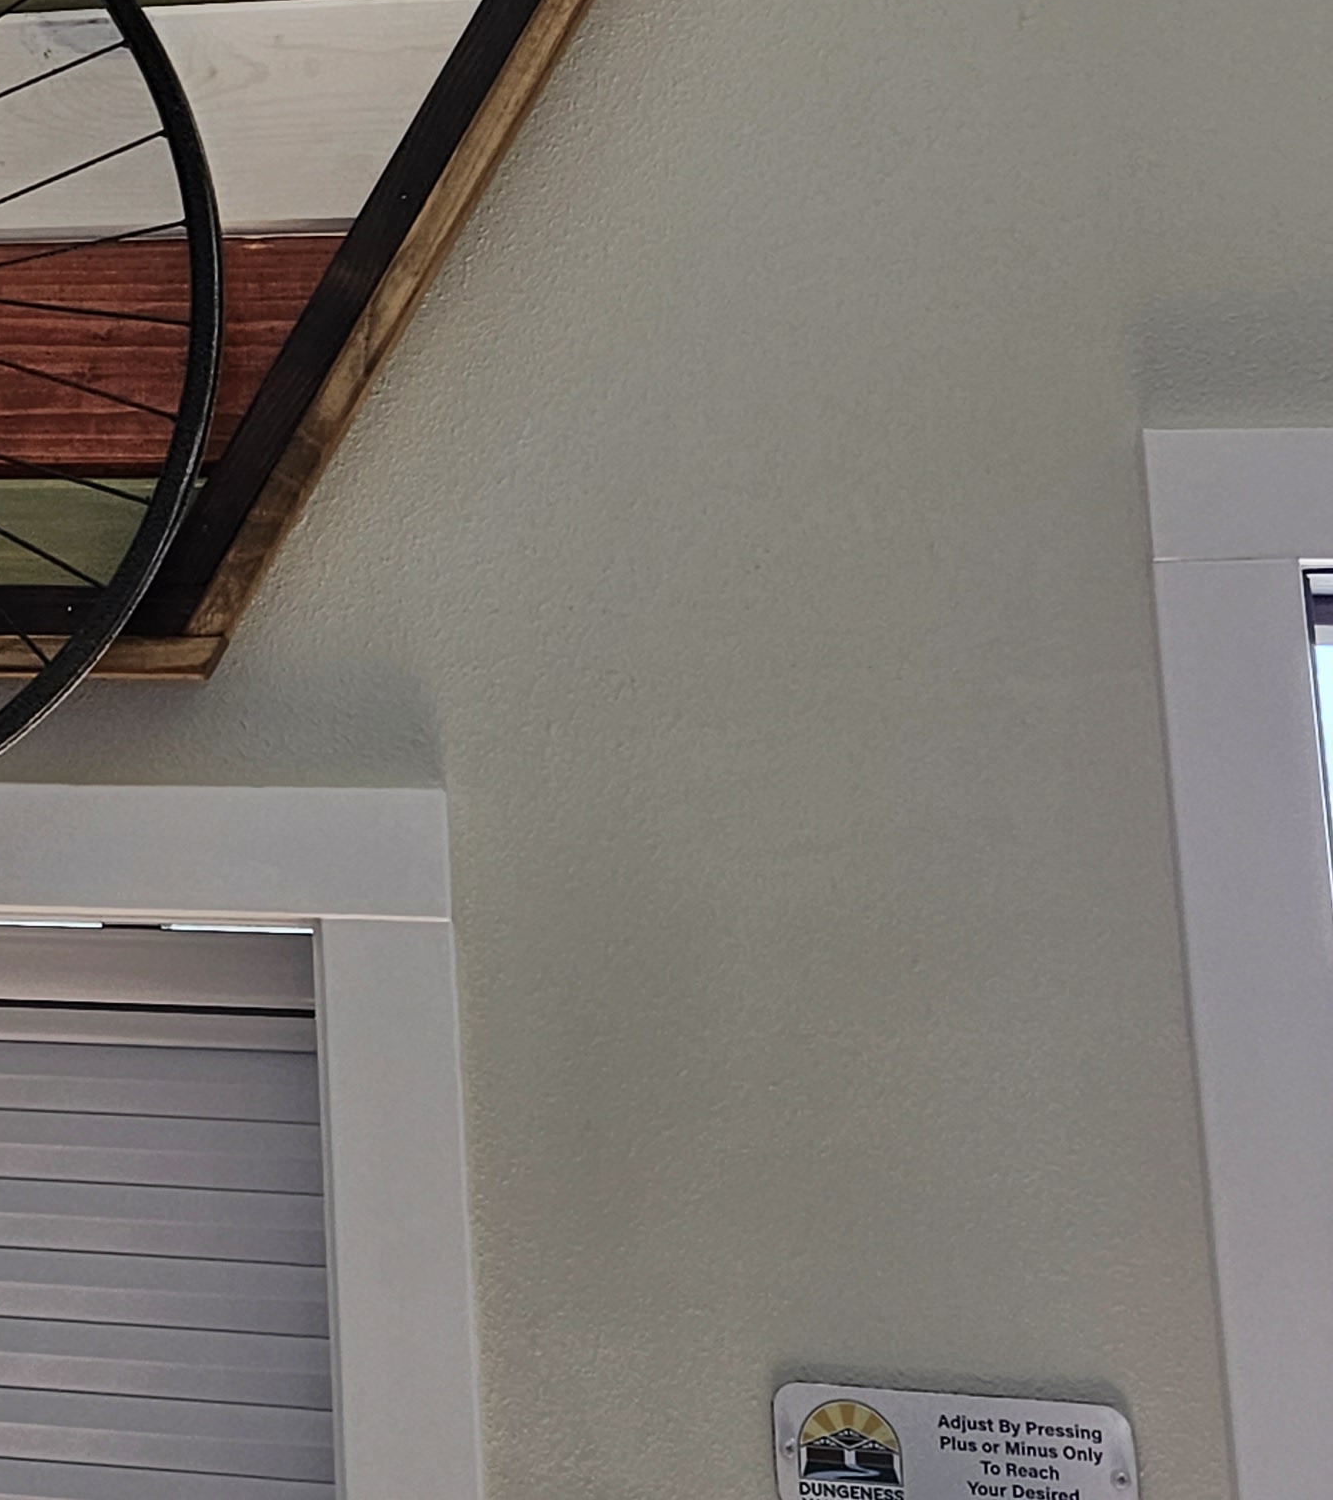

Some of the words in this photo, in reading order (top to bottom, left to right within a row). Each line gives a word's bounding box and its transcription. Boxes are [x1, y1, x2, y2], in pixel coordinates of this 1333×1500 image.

[937, 1414, 995, 1434] Adjust
[998, 1419, 1021, 1438] By
[1025, 1421, 1103, 1445] Pressing
[939, 1436, 978, 1453] Plus
[982, 1441, 1001, 1454] or
[1005, 1441, 1059, 1460] Minus
[1062, 1445, 1104, 1466] Only
[979, 1460, 1001, 1476] To
[1005, 1462, 1060, 1481] Reach
[798, 1481, 905, 1500] DUNGENESS
[966, 1480, 1008, 1498] Your
